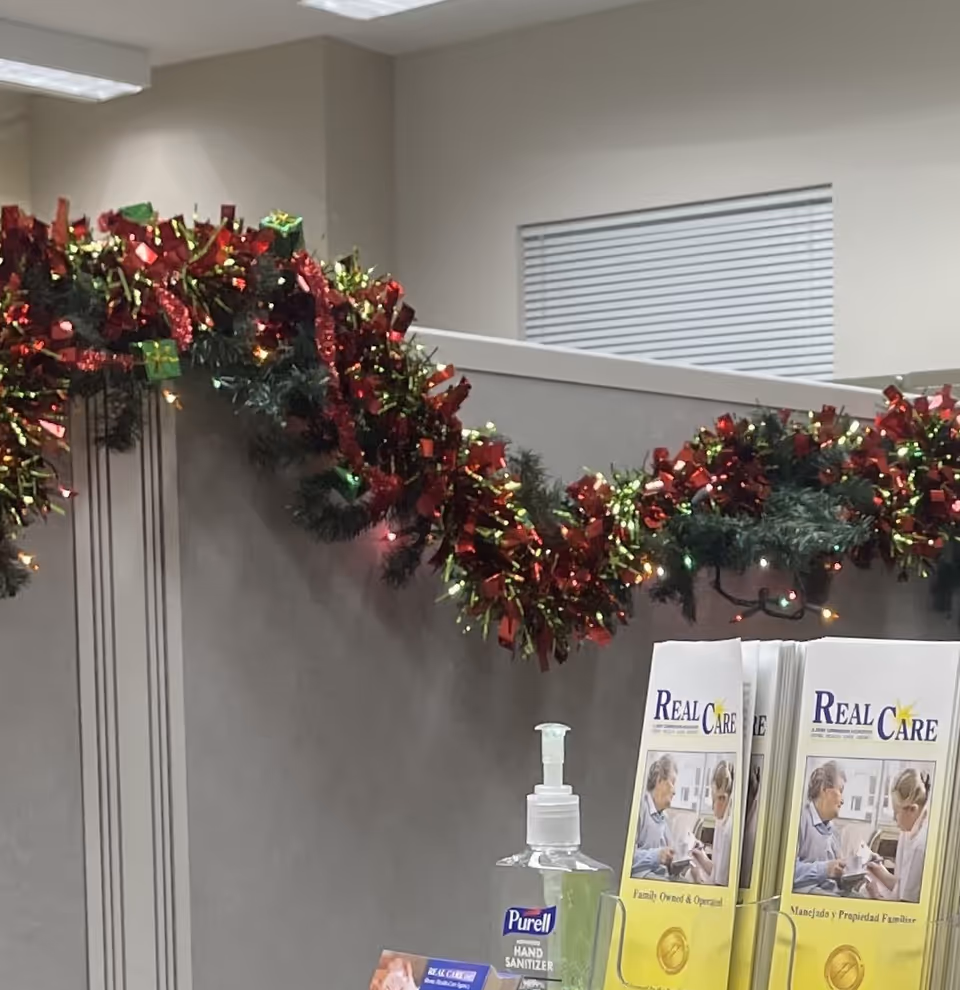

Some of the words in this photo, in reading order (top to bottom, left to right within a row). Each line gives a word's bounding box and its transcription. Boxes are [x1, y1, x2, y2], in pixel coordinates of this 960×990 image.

[654, 689, 700, 721] REAL
[702, 702, 737, 735] CARE
[812, 690, 874, 726] REAL
[877, 706, 938, 742] CARE
[508, 909, 551, 933] Purell
[790, 905, 830, 919] Manejado
[838, 909, 880, 923] Propiedad
[513, 945, 543, 959] HAND
[505, 956, 554, 972] SANITIZER
